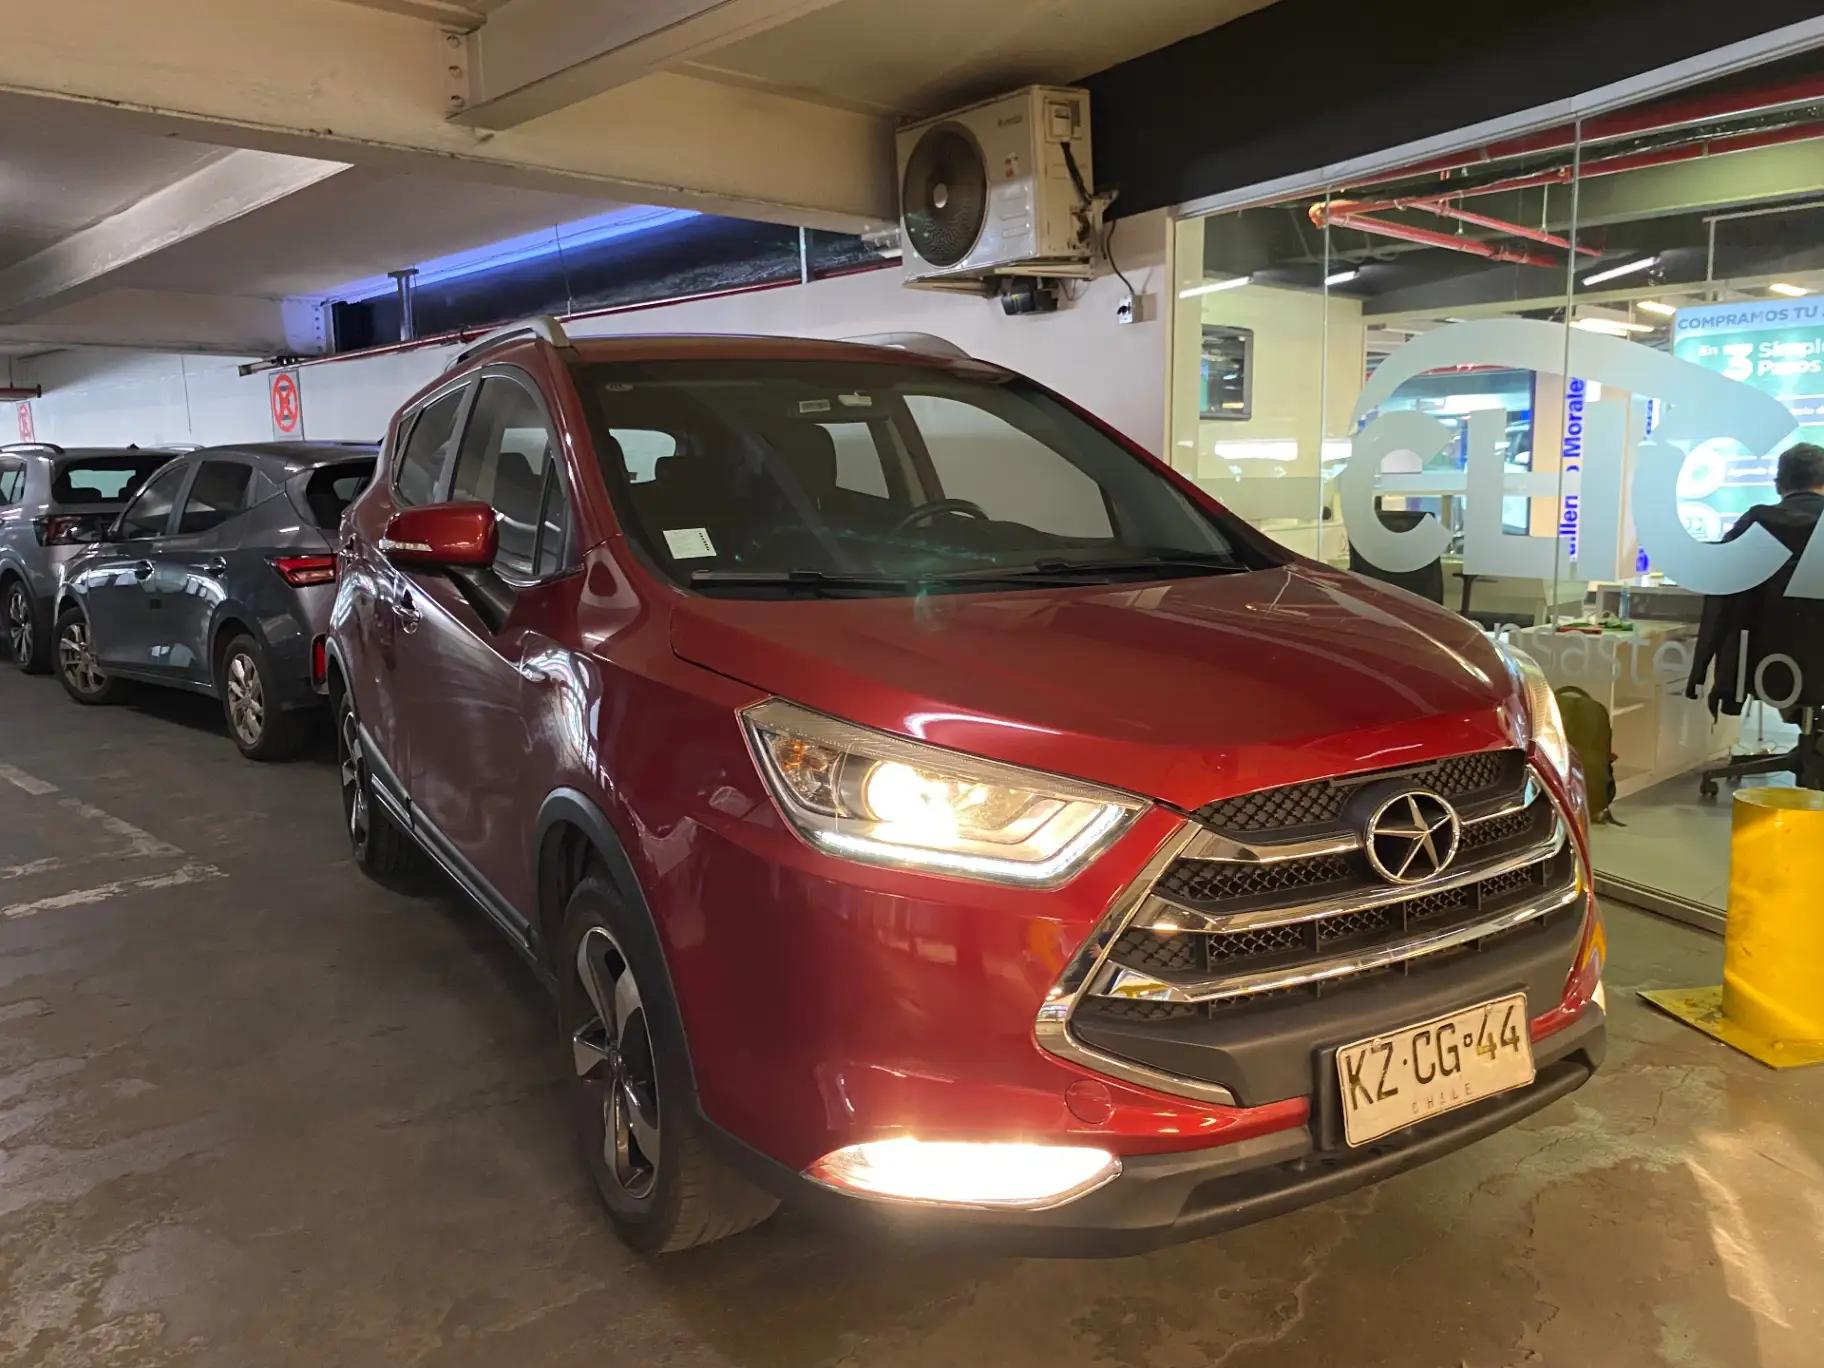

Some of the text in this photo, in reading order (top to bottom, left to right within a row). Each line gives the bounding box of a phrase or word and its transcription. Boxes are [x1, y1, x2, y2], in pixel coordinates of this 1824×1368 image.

[1677, 305, 1819, 330] COMPRAMOS TU
[1721, 342, 1754, 383] 3
[1561, 376, 1586, 459] Morale
[1735, 628, 1803, 710] lo
[1411, 1082, 1473, 1115] CHILE
